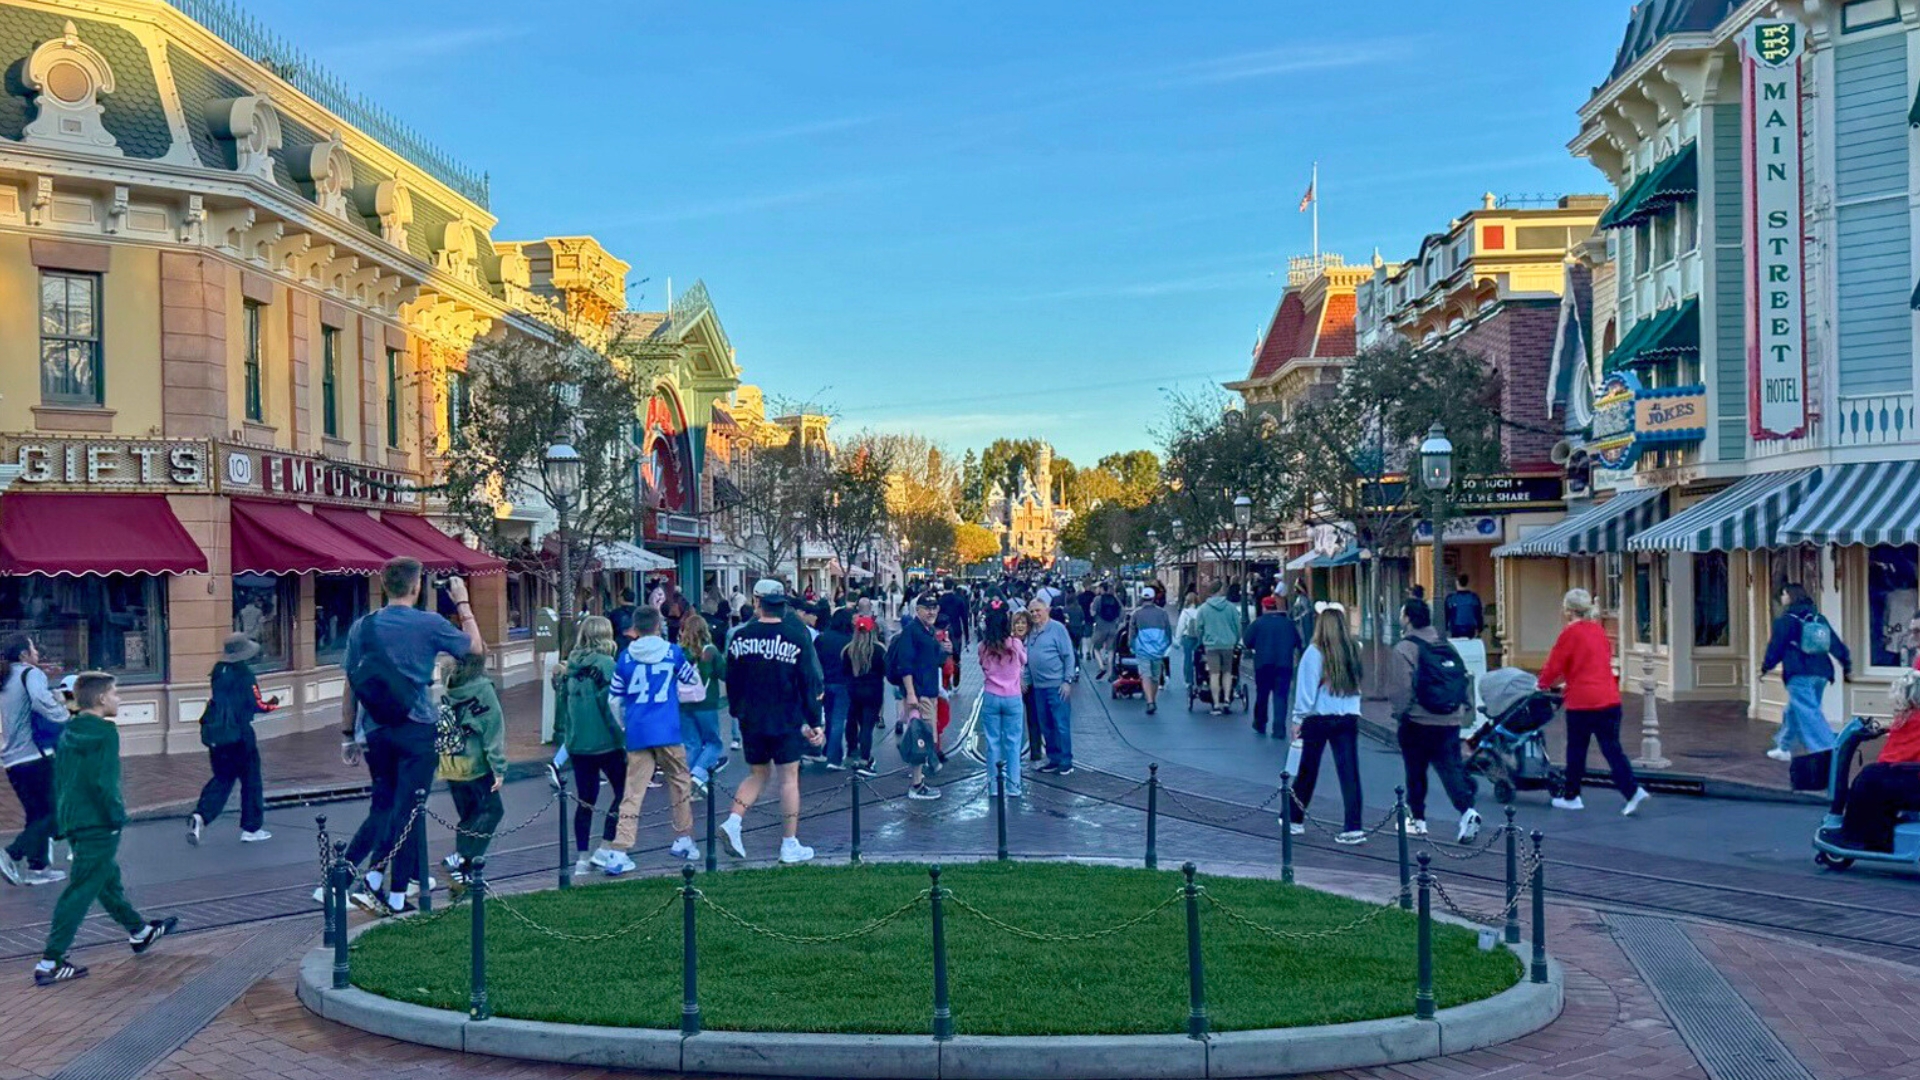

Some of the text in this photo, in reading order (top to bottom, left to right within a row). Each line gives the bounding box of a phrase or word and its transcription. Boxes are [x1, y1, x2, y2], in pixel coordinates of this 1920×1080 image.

[1763, 81, 1792, 363] MAIN STREET
[1766, 377, 1799, 404] HOTEL
[1646, 403, 1695, 426] JOKES
[18, 444, 201, 484] GIFTS
[231, 458, 249, 478] 101
[1496, 492, 1531, 502] SHARE
[627, 662, 675, 704] 47
